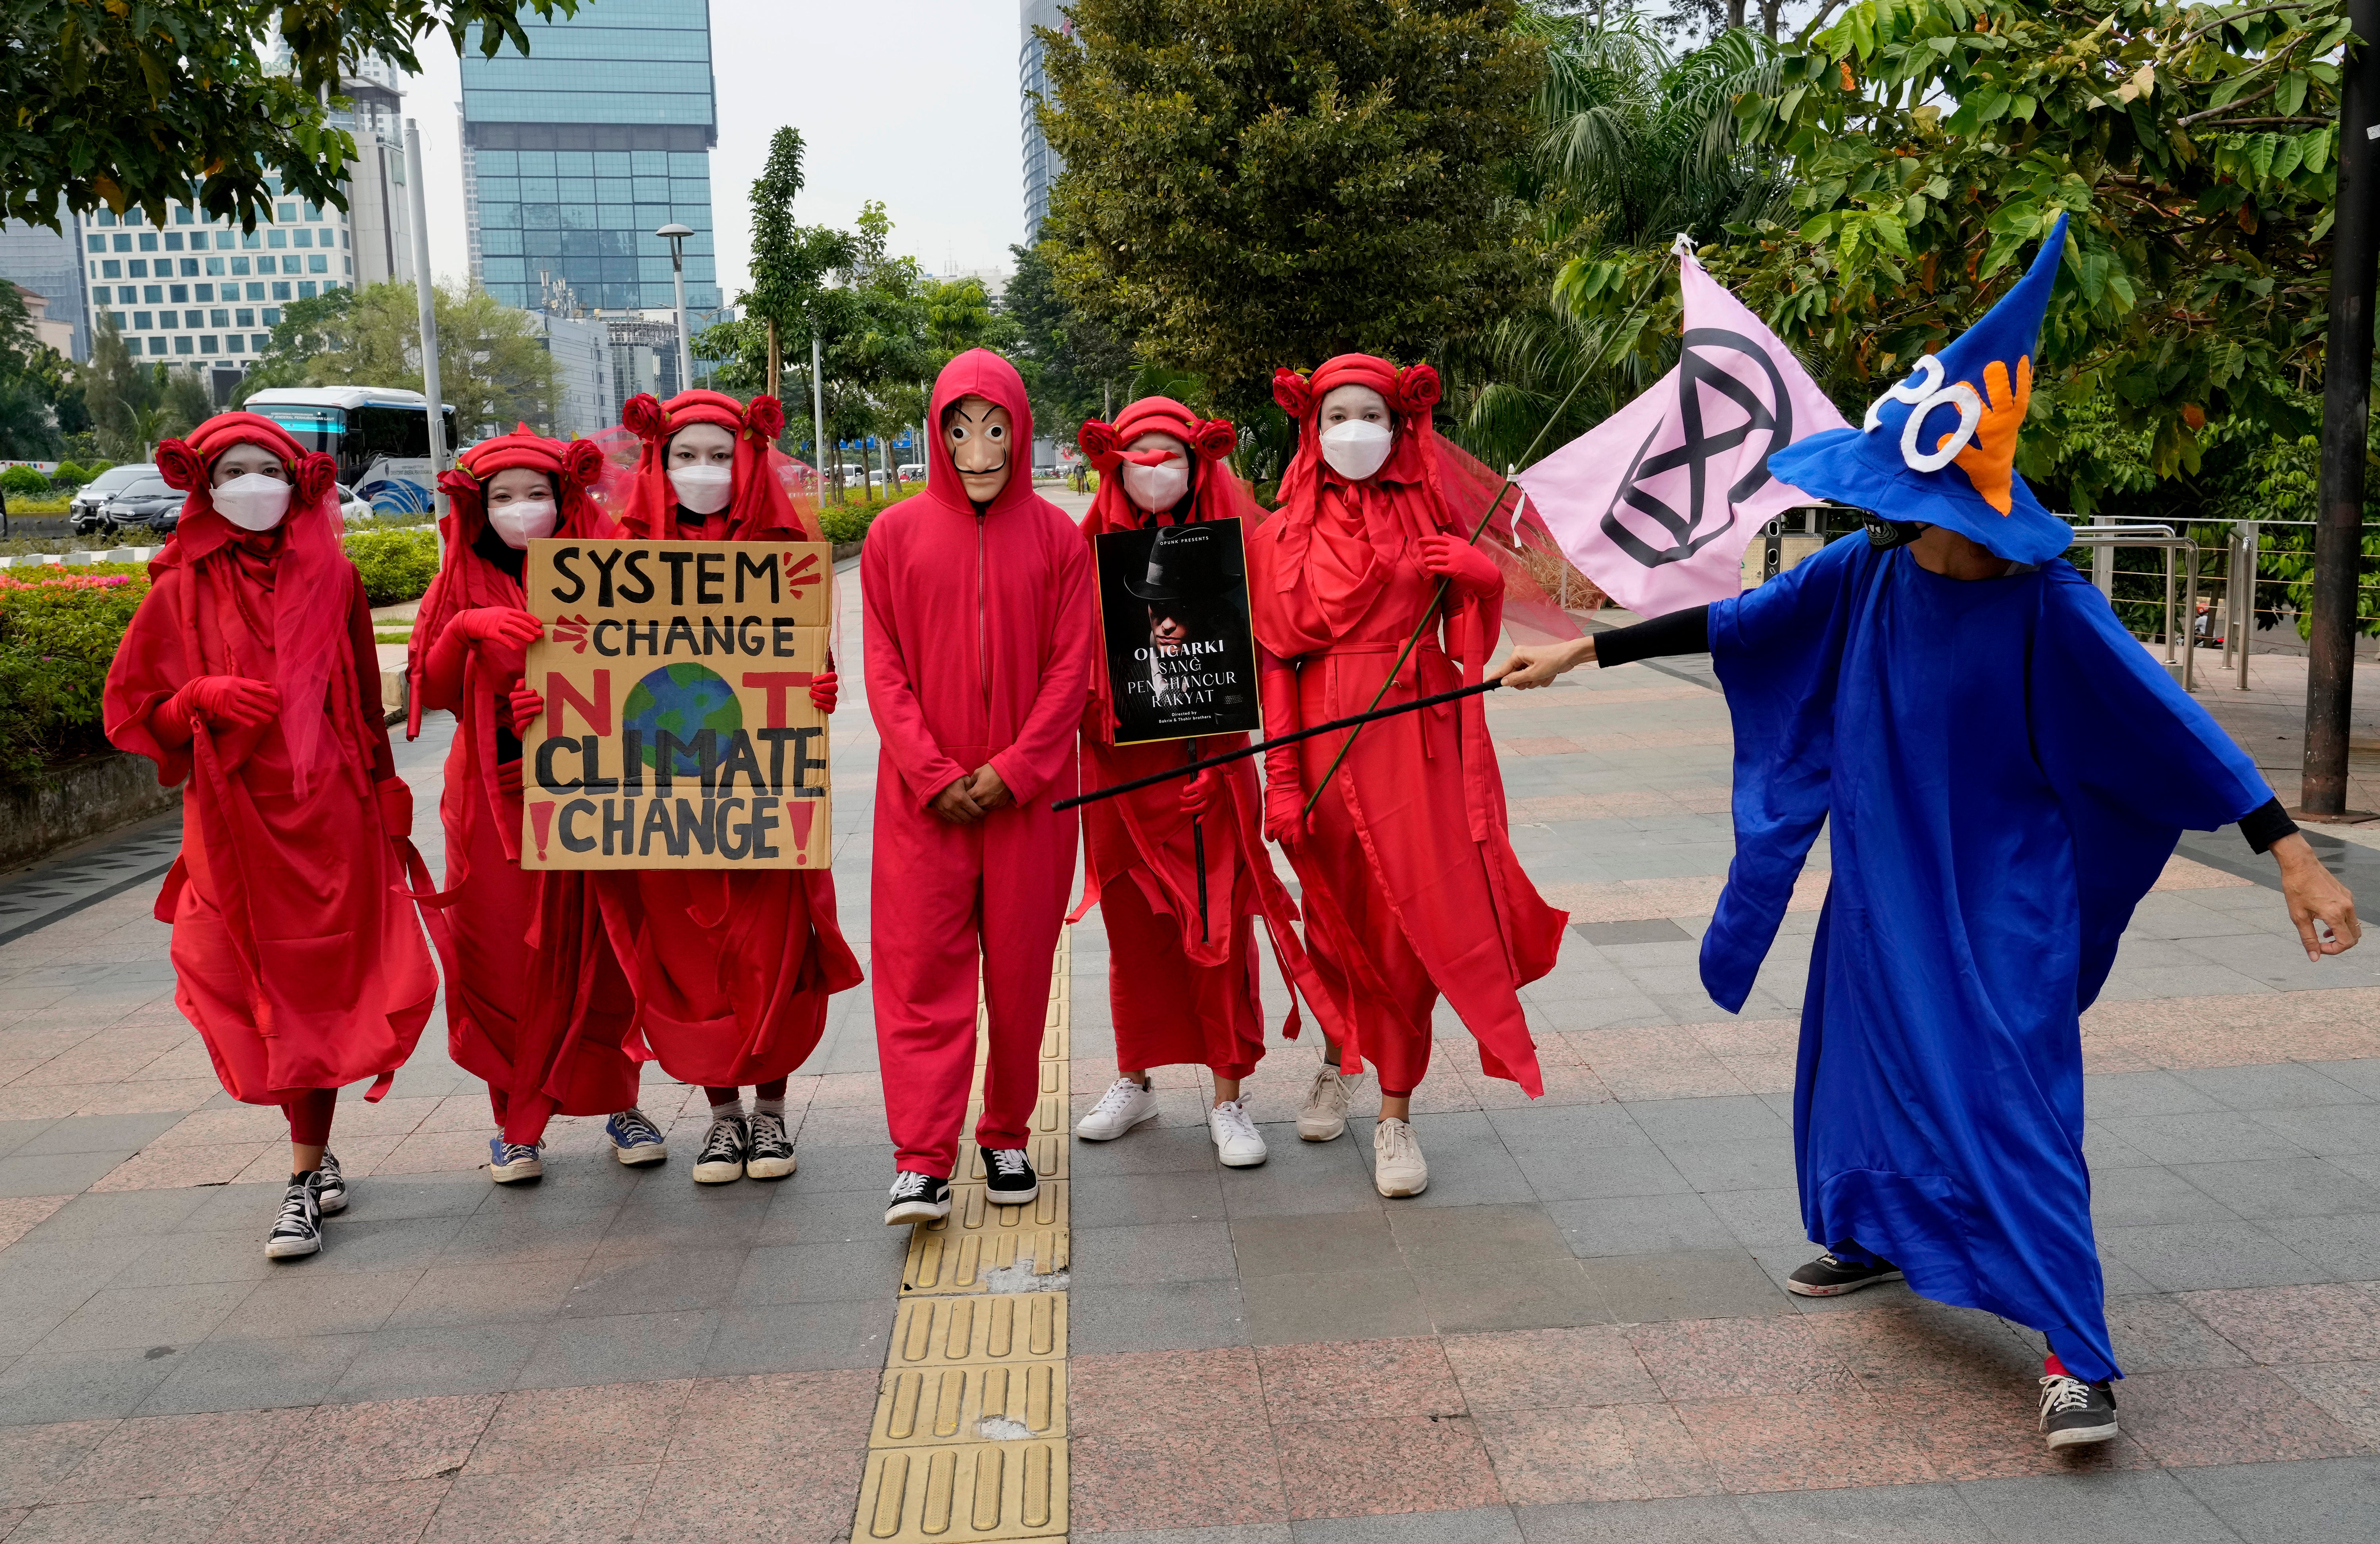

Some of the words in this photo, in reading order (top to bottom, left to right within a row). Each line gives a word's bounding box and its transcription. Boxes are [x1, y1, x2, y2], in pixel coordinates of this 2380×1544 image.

[551, 547, 779, 608] SYSTEM
[593, 616, 795, 657] CHANGE
[1134, 640, 1224, 661] OLIGARKI
[1159, 657, 1201, 674] SANG
[1128, 671, 1237, 694] PENGHANCUR
[1152, 690, 1214, 708] RAKYAT
[535, 727, 827, 798] CLIMATE
